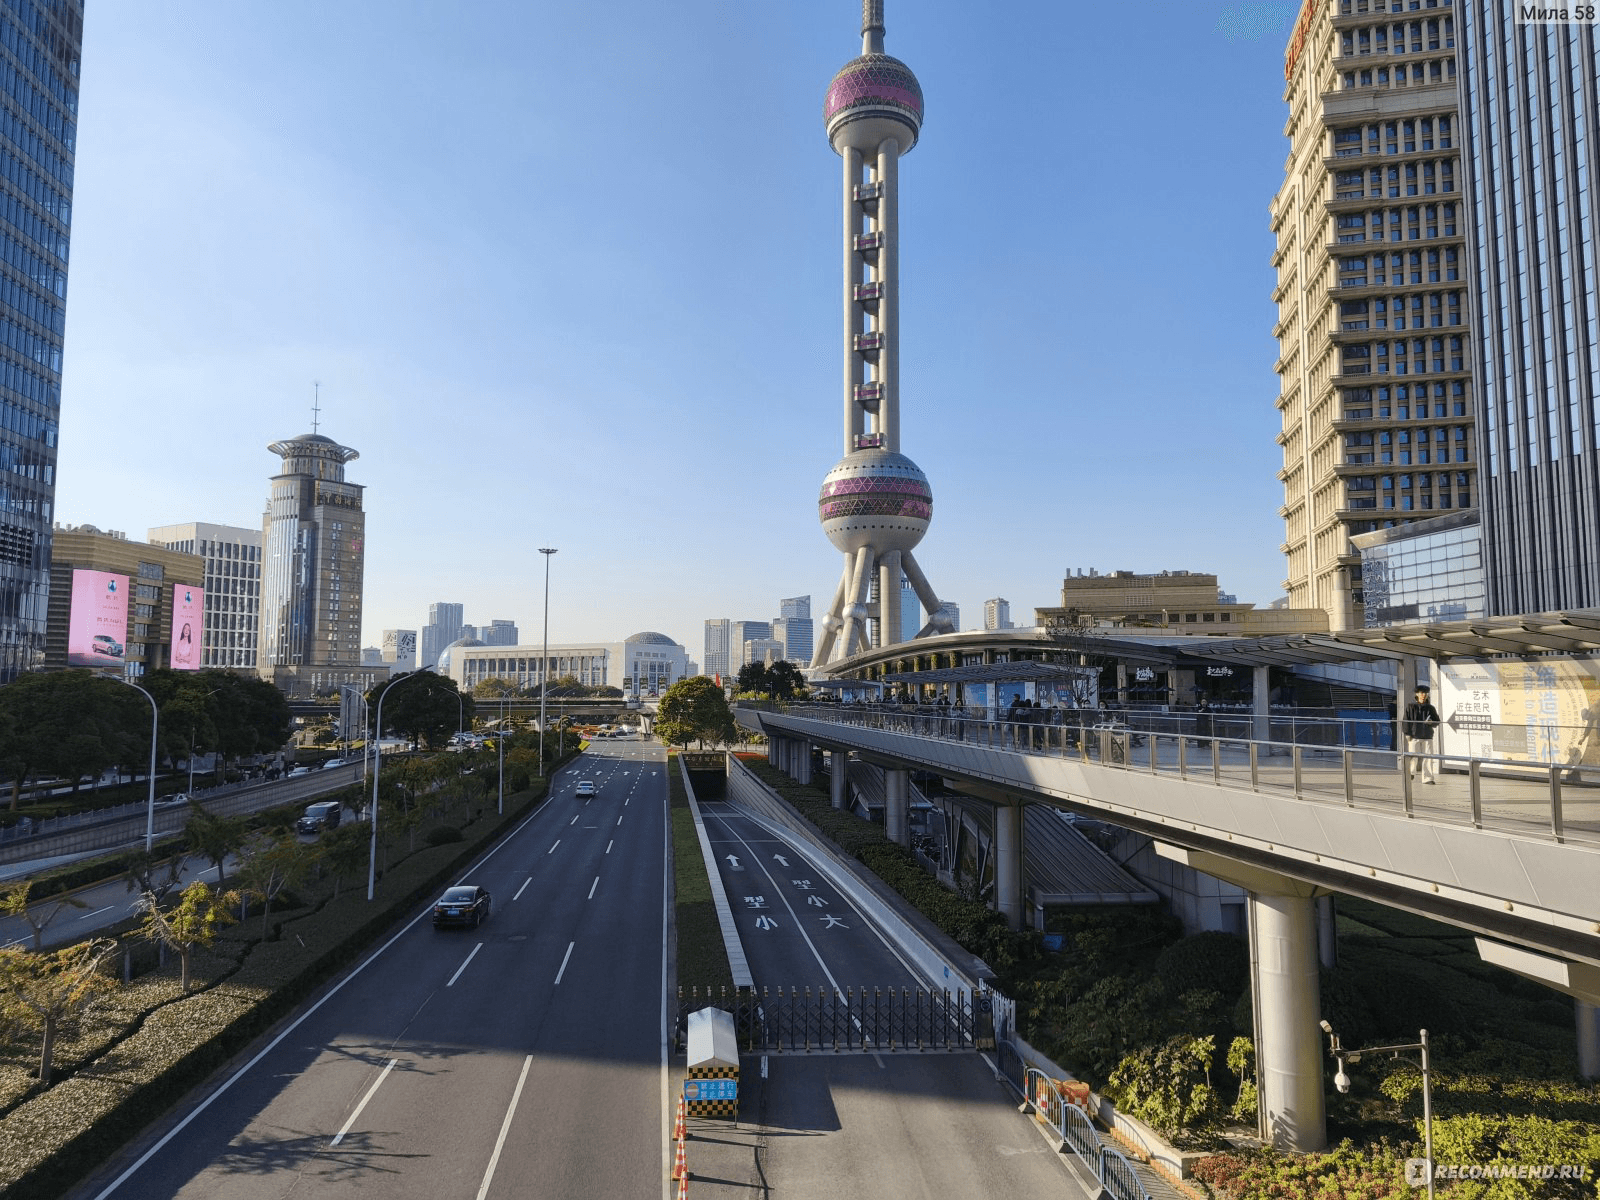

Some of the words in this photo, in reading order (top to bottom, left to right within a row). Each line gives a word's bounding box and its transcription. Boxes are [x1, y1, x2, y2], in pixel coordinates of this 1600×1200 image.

[1472, 690, 1490, 701] 艺术
[1456, 702, 1491, 713] 近在咫尺
